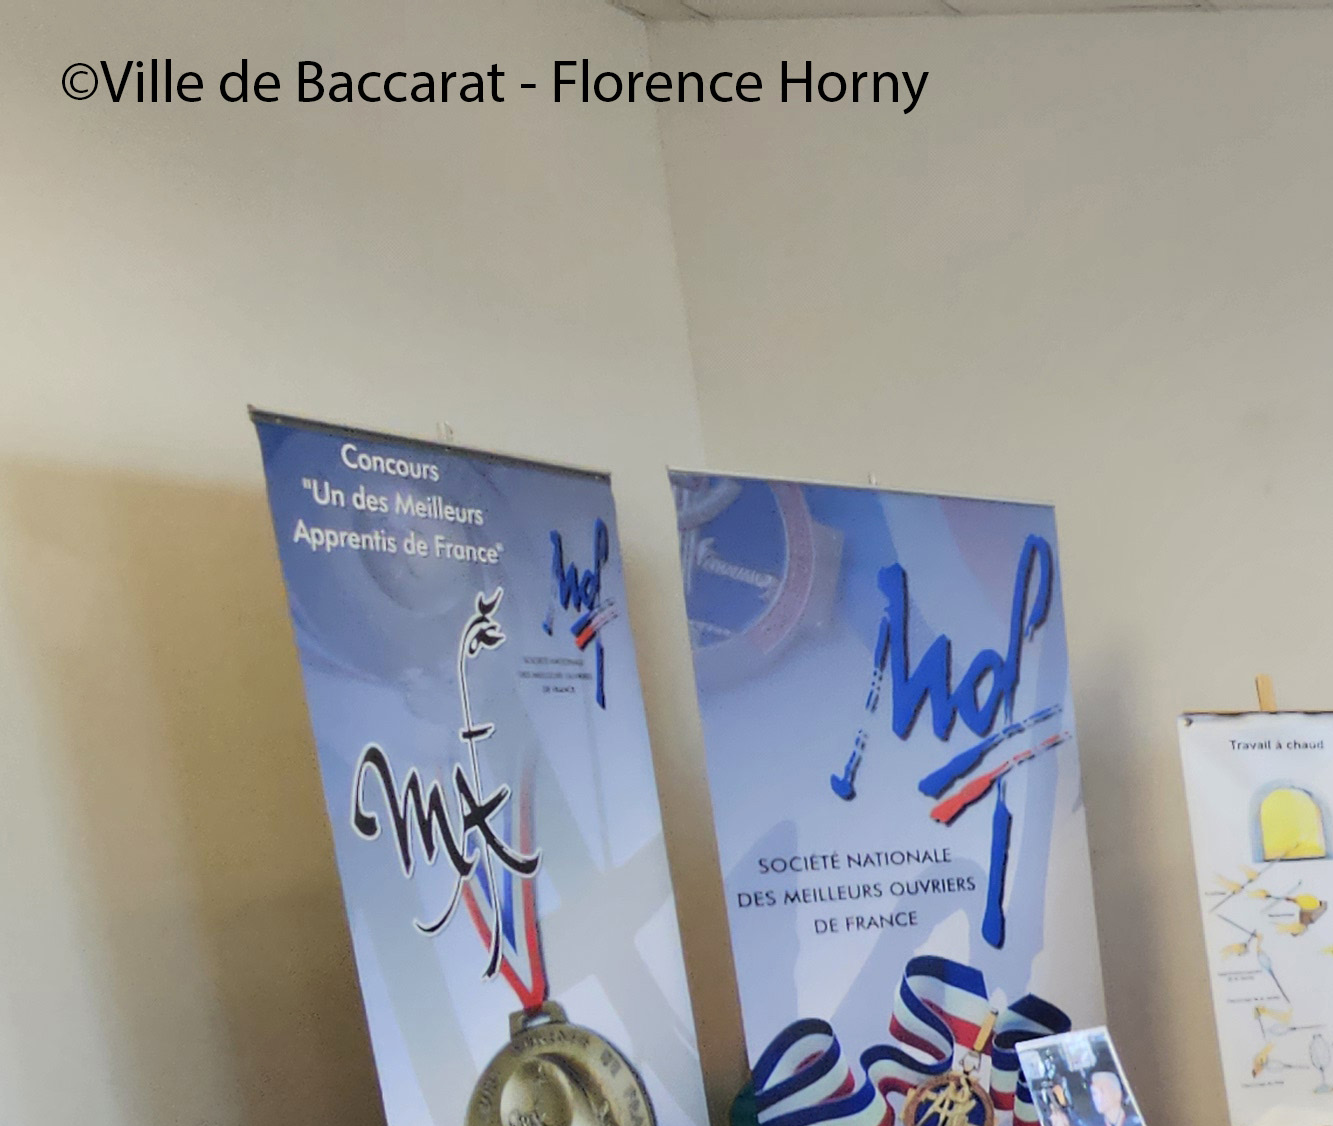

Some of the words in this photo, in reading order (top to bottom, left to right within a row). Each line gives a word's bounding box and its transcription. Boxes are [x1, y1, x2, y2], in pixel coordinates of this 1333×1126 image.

[340, 443, 440, 482] Concours
[302, 477, 345, 508] "Un
[352, 485, 389, 513] des
[395, 492, 484, 526] Meilleurs
[293, 518, 397, 554] Apprentis
[403, 530, 429, 556] de
[1229, 739, 1272, 750] Travail
[1286, 739, 1325, 750] chaud
[758, 853, 842, 875] SOCIÉTÉ
[846, 848, 953, 869] NATIONALE
[737, 890, 777, 909] DES
[783, 883, 883, 907] MEILLEURS
[889, 875, 977, 898] OUVRIERS
[813, 917, 839, 935] DE
[845, 910, 919, 932] FRANCE
